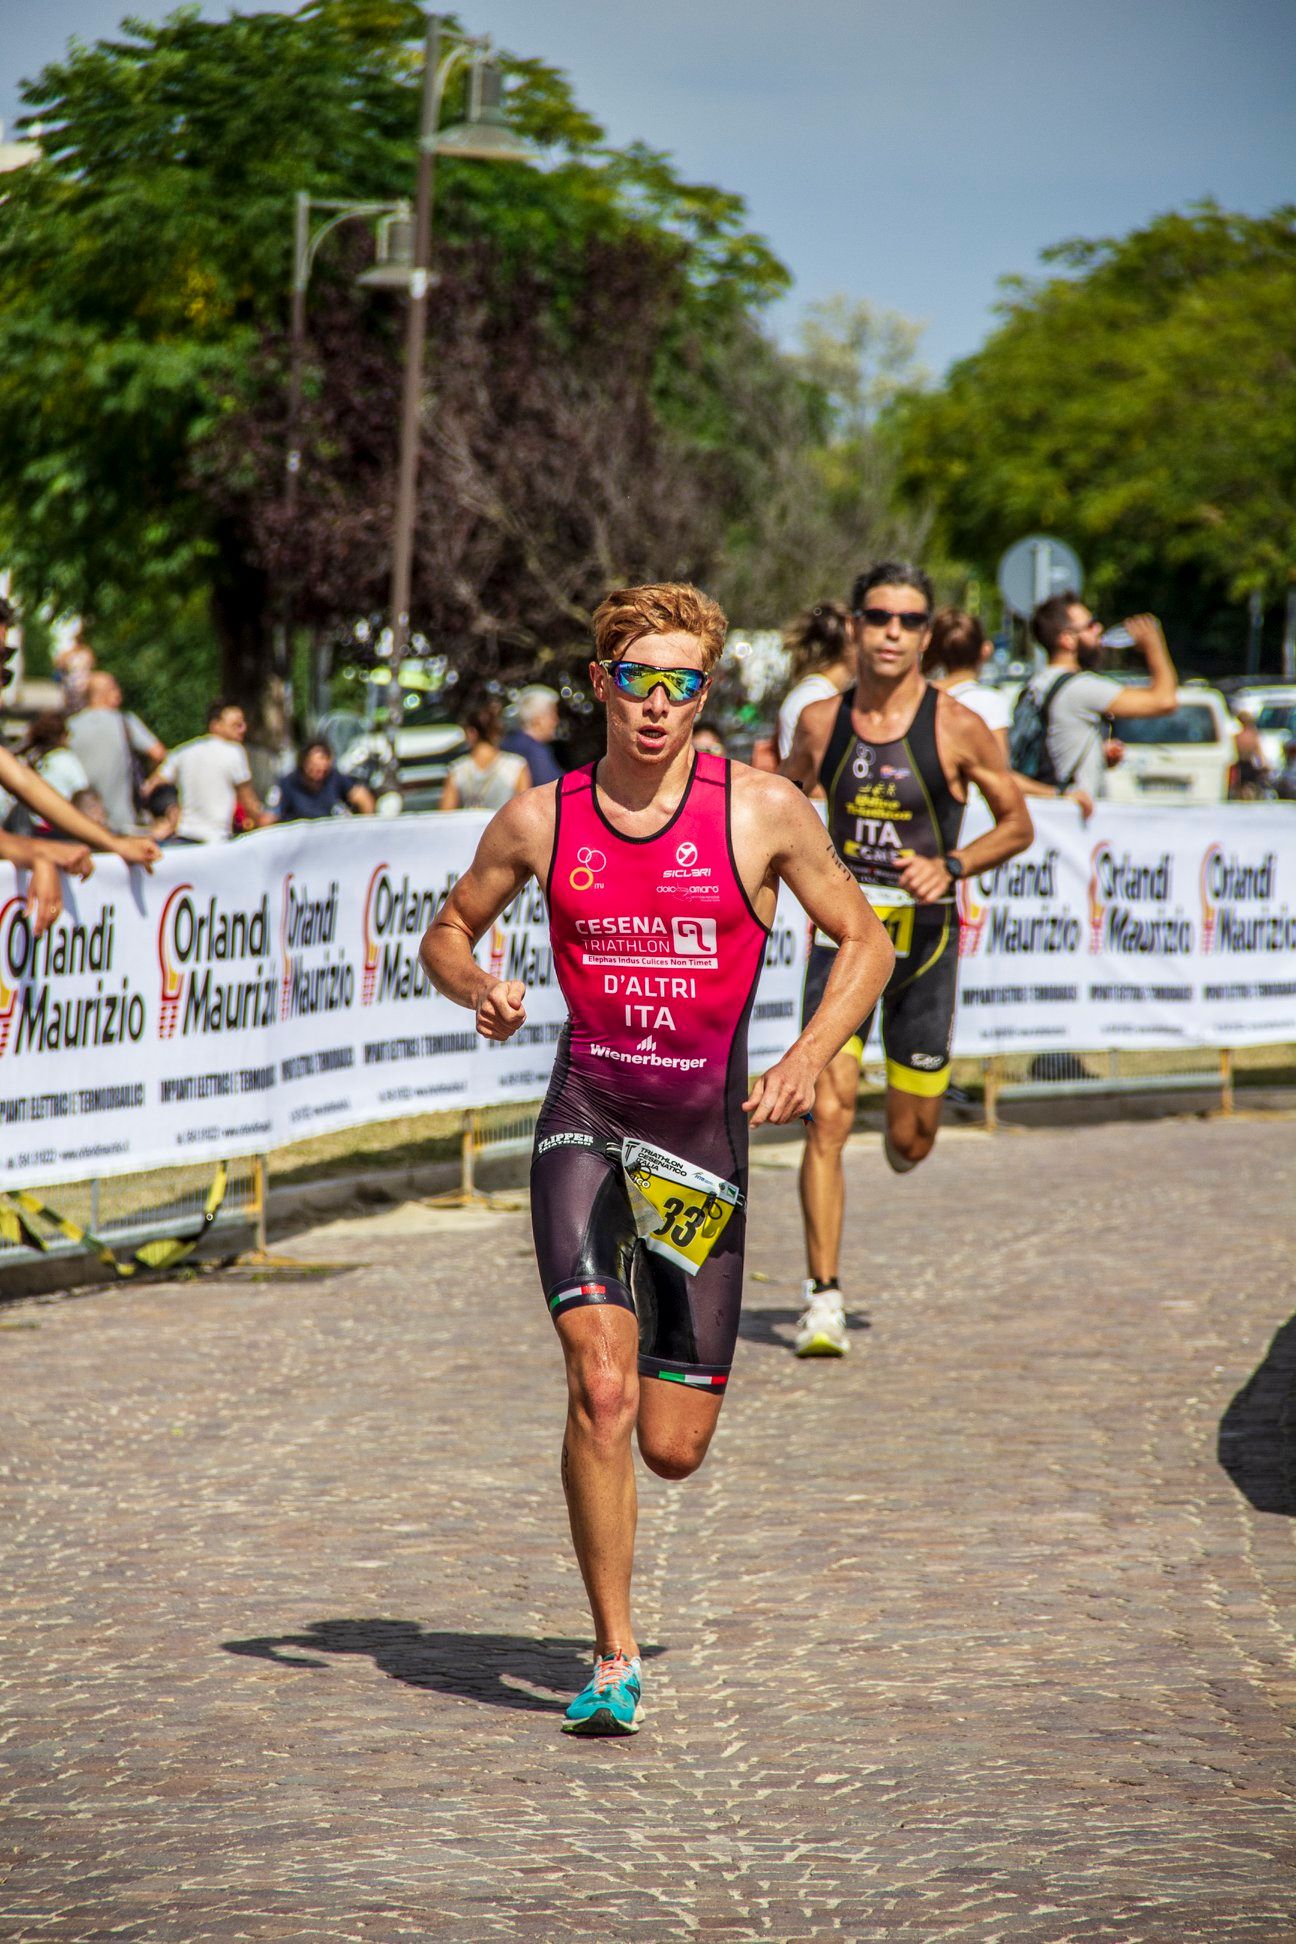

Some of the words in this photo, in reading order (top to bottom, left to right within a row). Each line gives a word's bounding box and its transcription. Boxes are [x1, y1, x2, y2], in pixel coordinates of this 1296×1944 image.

[855, 817, 903, 848] ITA
[575, 916, 667, 935] CESENA
[7, 903, 115, 978] Orlandi
[582, 939, 670, 953] TRIATHLON
[588, 955, 617, 963] Elephas
[641, 957, 668, 965] Culices
[670, 958, 687, 966] Non
[604, 975, 696, 998] D'ALTRI
[14, 976, 146, 1055] Maurizio
[625, 1004, 676, 1030] ITA
[590, 1043, 707, 1070] Wienerberger
[538, 1132, 593, 1150] FLIPPER
[638, 1153, 687, 1177] CESENATICO
[641, 1147, 683, 1169] TRIATHLON
[653, 1197, 705, 1247] 33
